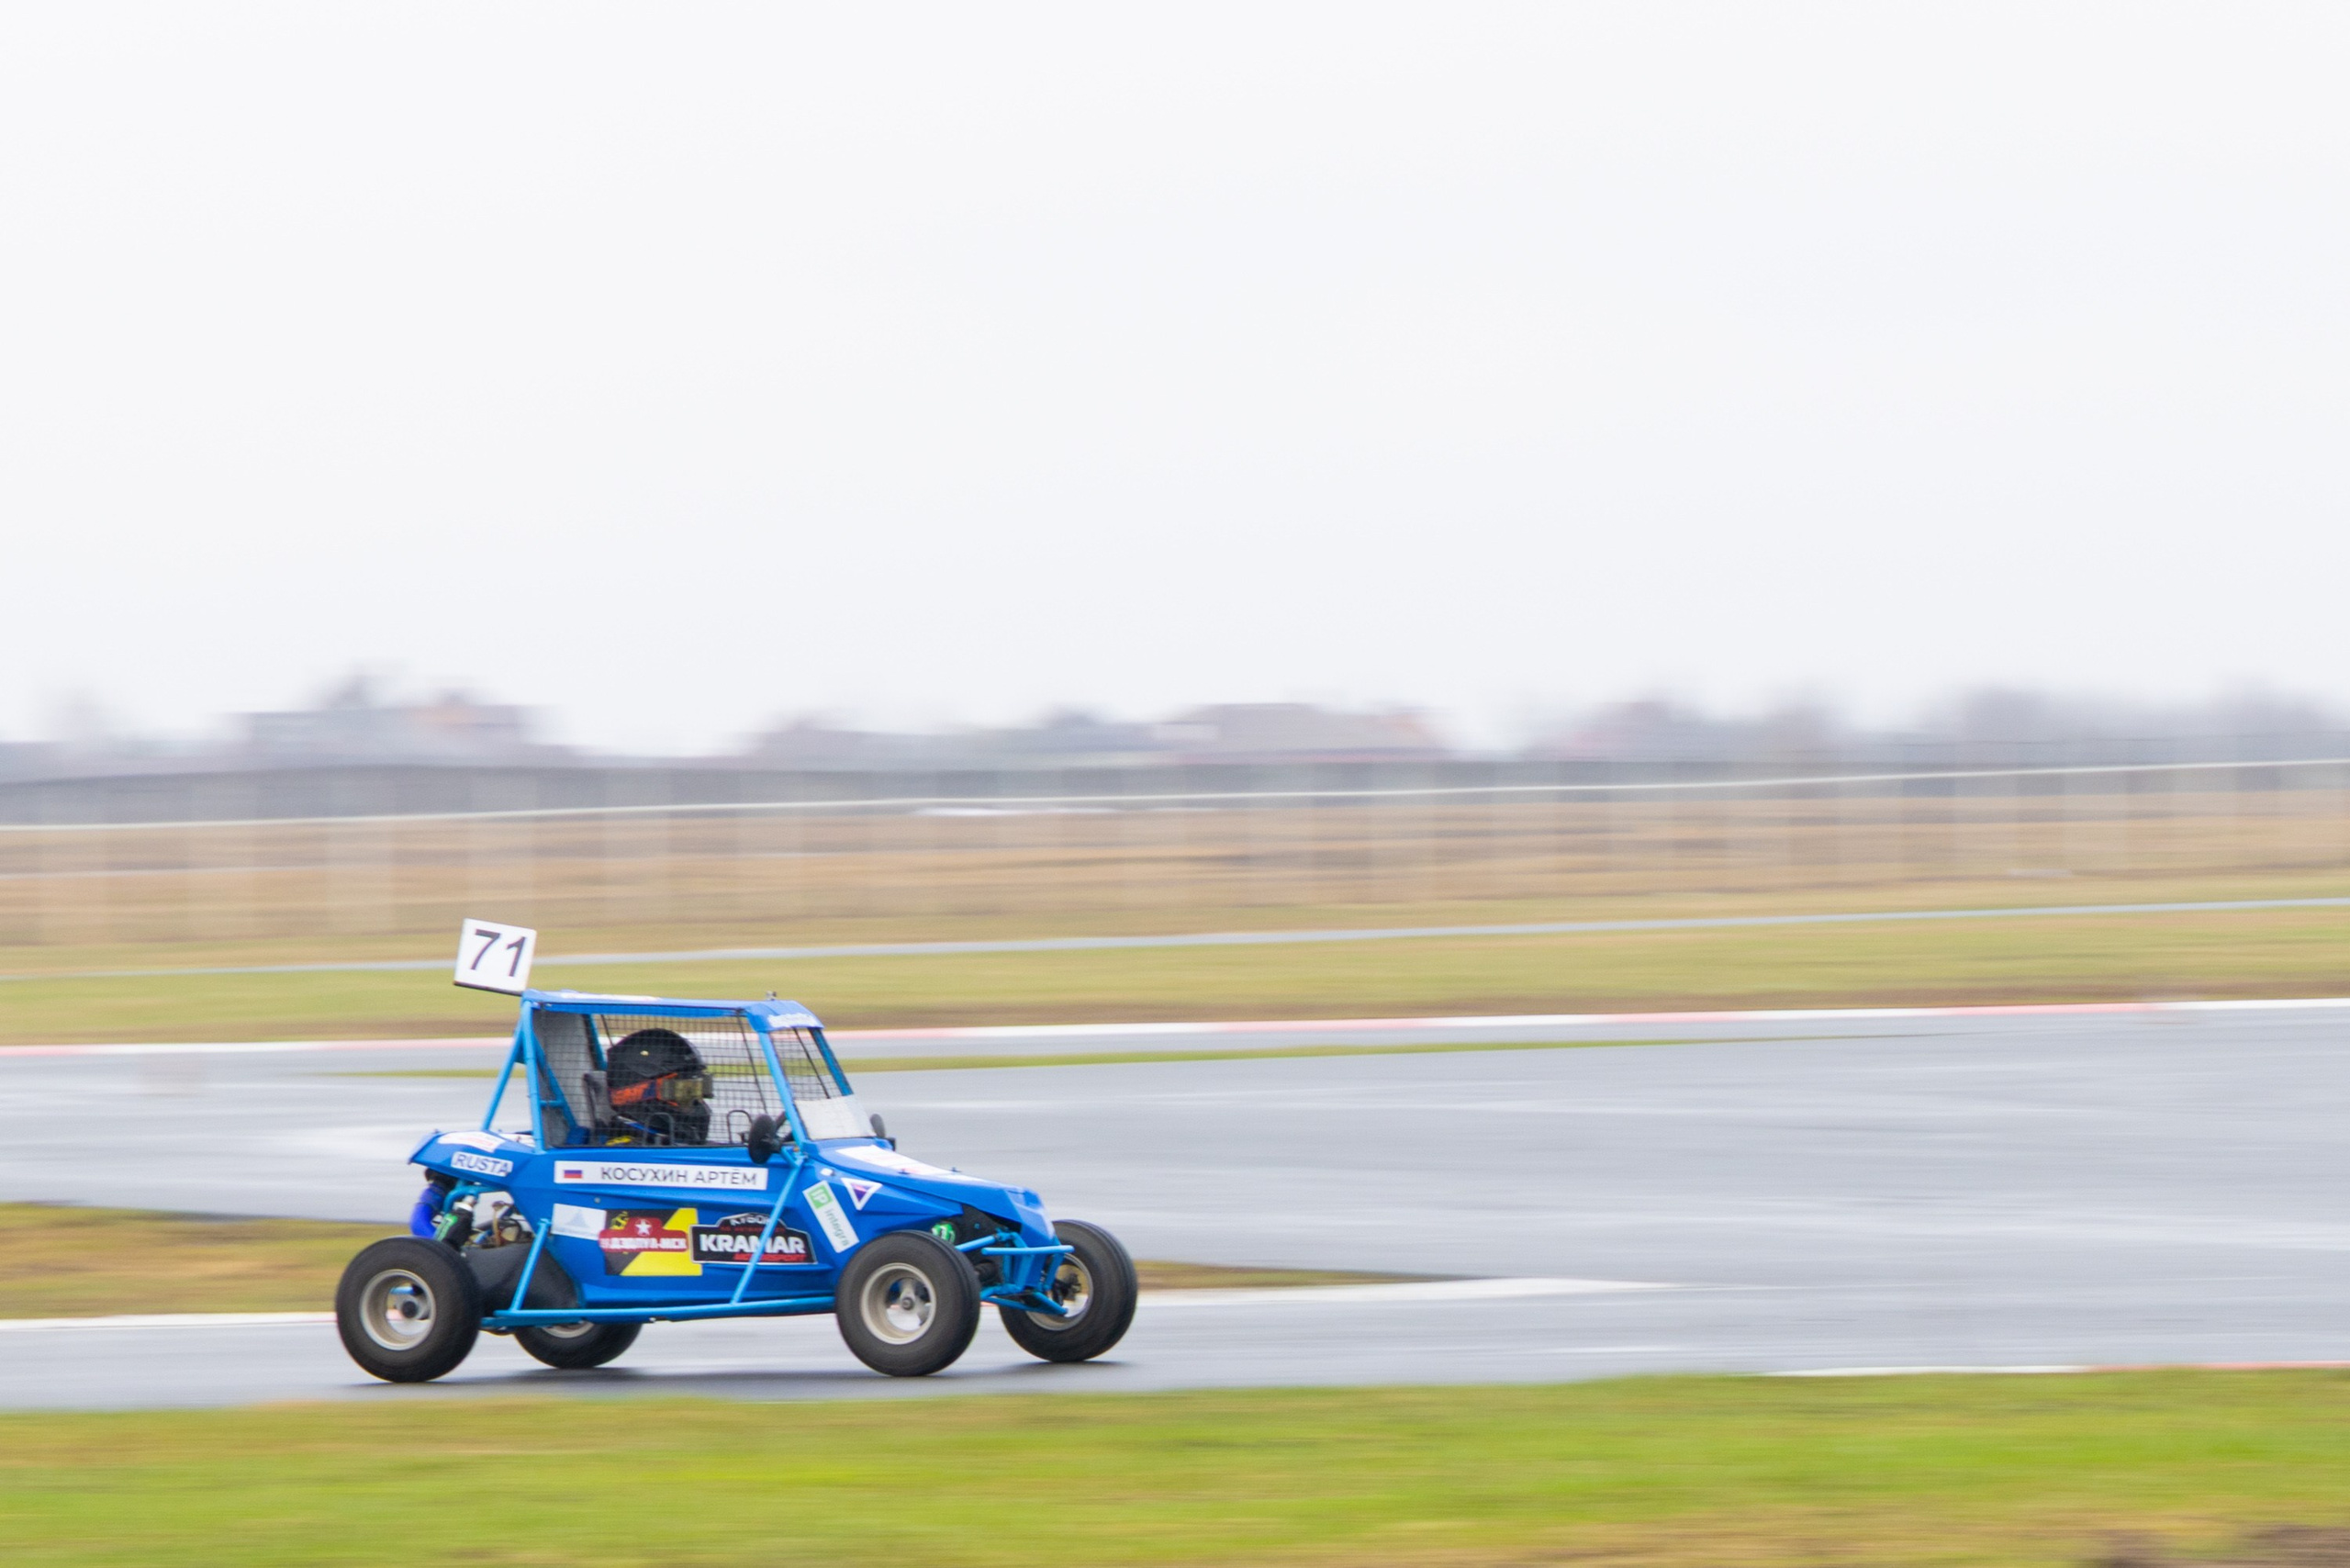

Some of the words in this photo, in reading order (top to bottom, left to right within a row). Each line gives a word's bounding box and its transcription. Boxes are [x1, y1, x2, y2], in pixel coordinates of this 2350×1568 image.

[471, 928, 526, 978] 71
[454, 1154, 509, 1174] RUSTA
[599, 1166, 688, 1182] КОСУХИН
[693, 1168, 757, 1186] АРТЁМ
[699, 1233, 806, 1254] KRAMAR
